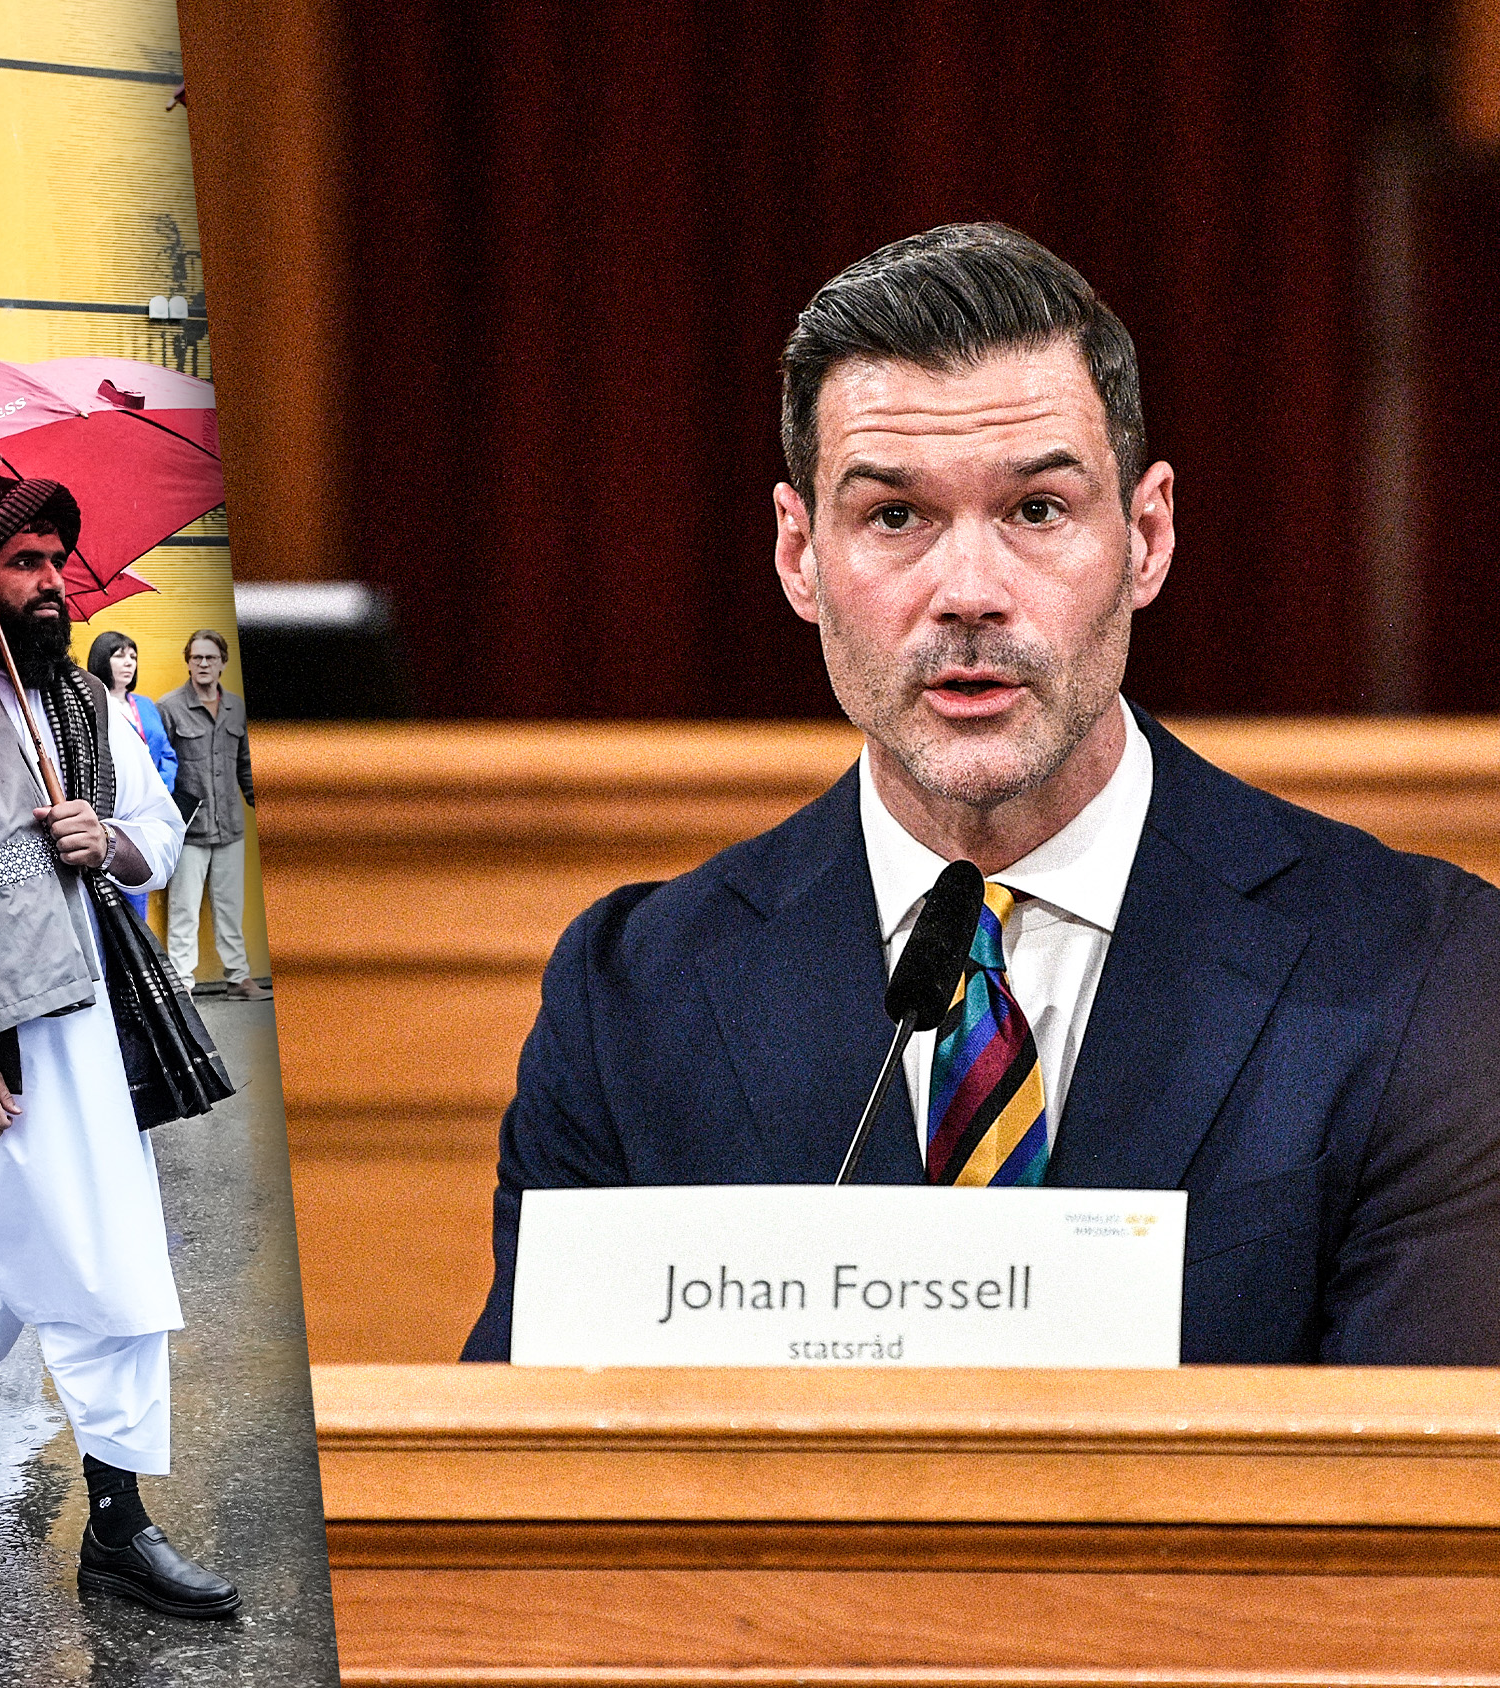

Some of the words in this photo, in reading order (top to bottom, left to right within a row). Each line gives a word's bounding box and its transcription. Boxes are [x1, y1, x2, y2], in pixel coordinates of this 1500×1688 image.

[658, 1265, 806, 1324] Johan
[833, 1264, 1031, 1310] Forssell
[788, 1334, 905, 1360] statsråd
